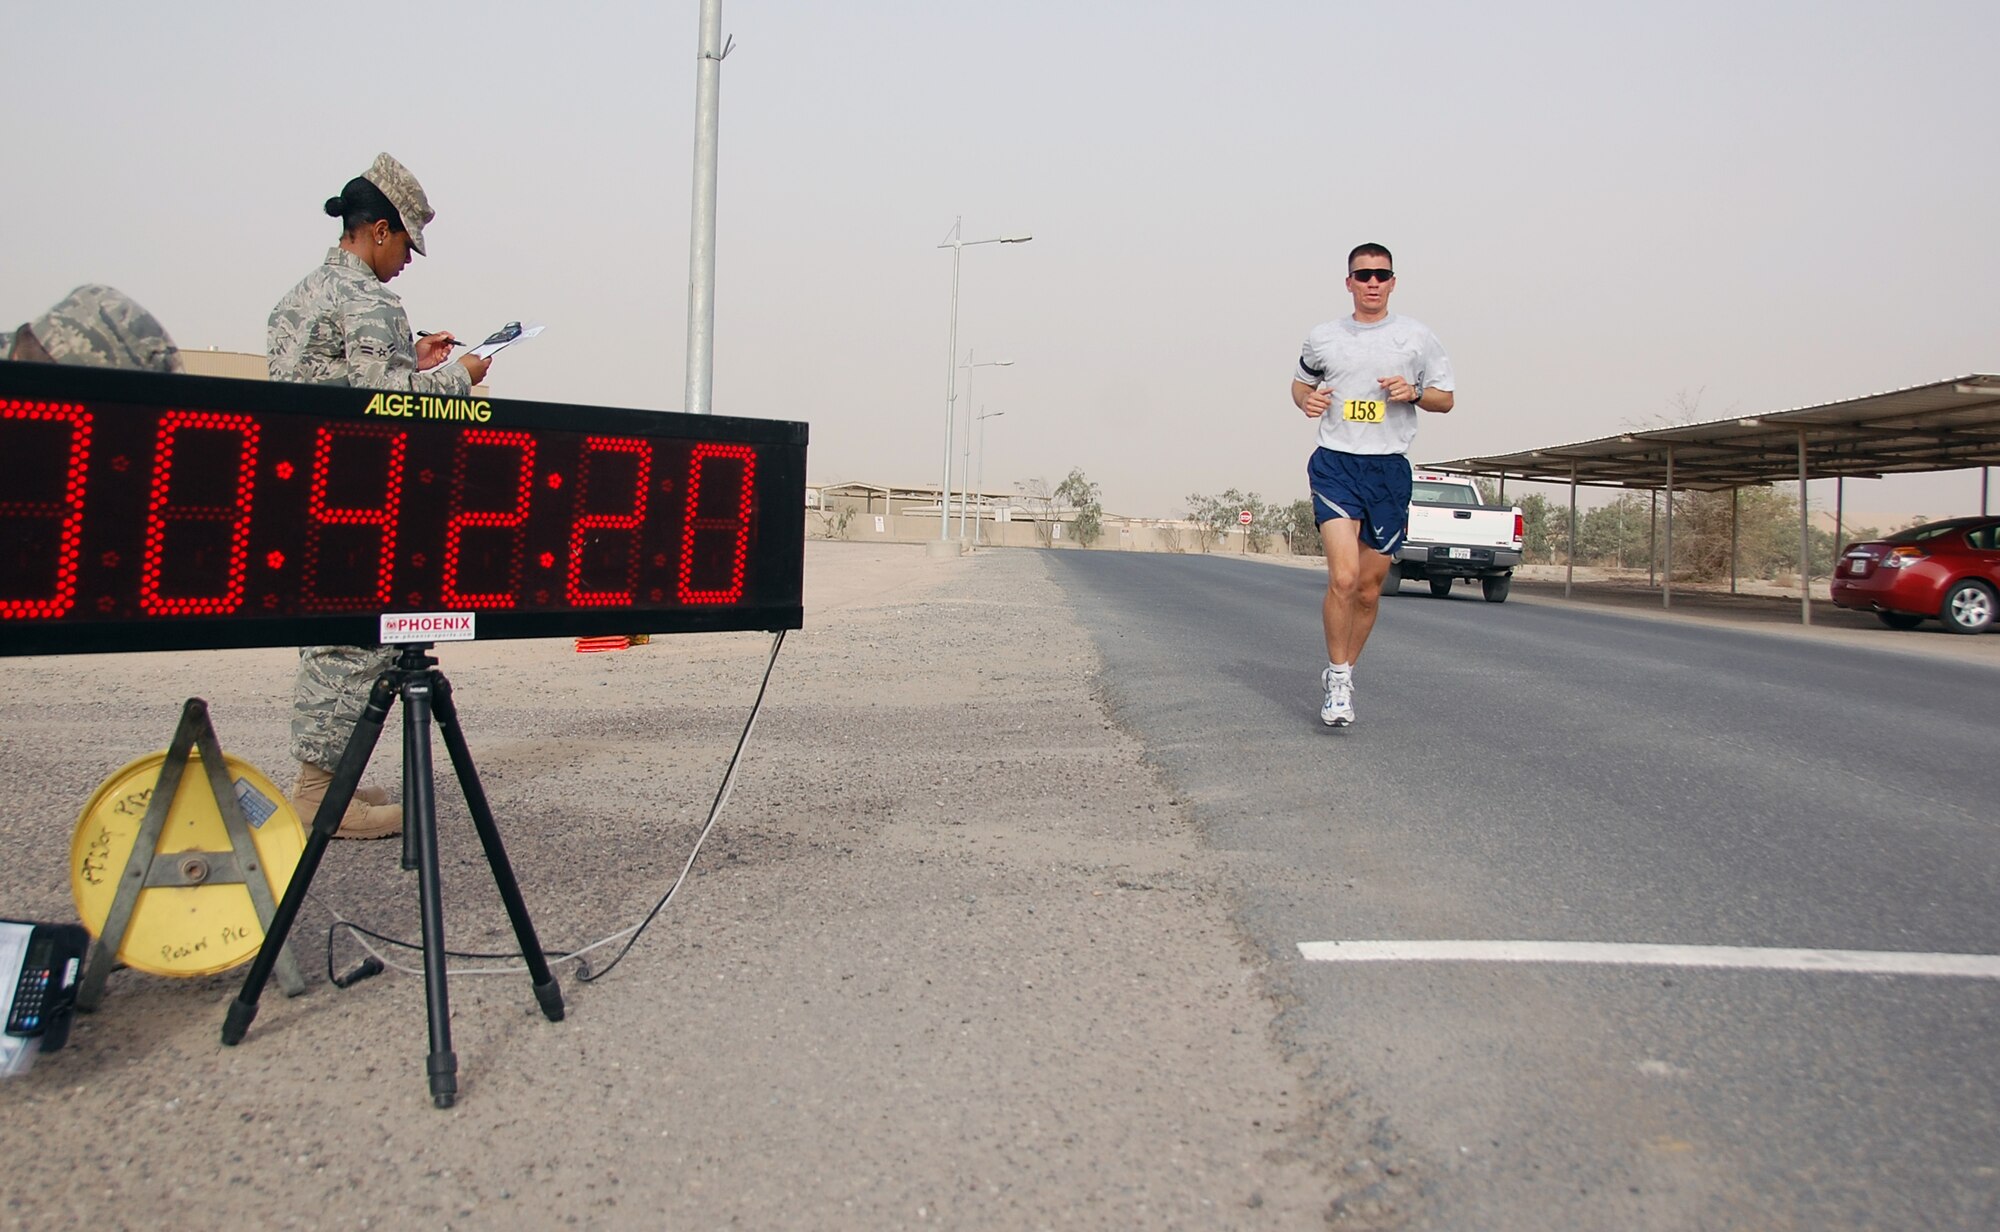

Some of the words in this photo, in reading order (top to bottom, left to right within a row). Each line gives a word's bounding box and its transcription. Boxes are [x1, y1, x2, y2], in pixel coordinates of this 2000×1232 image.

[364, 393, 492, 422] ALGE-TIMING
[1350, 401, 1376, 421] 158
[398, 617, 470, 631] PHOENIX
